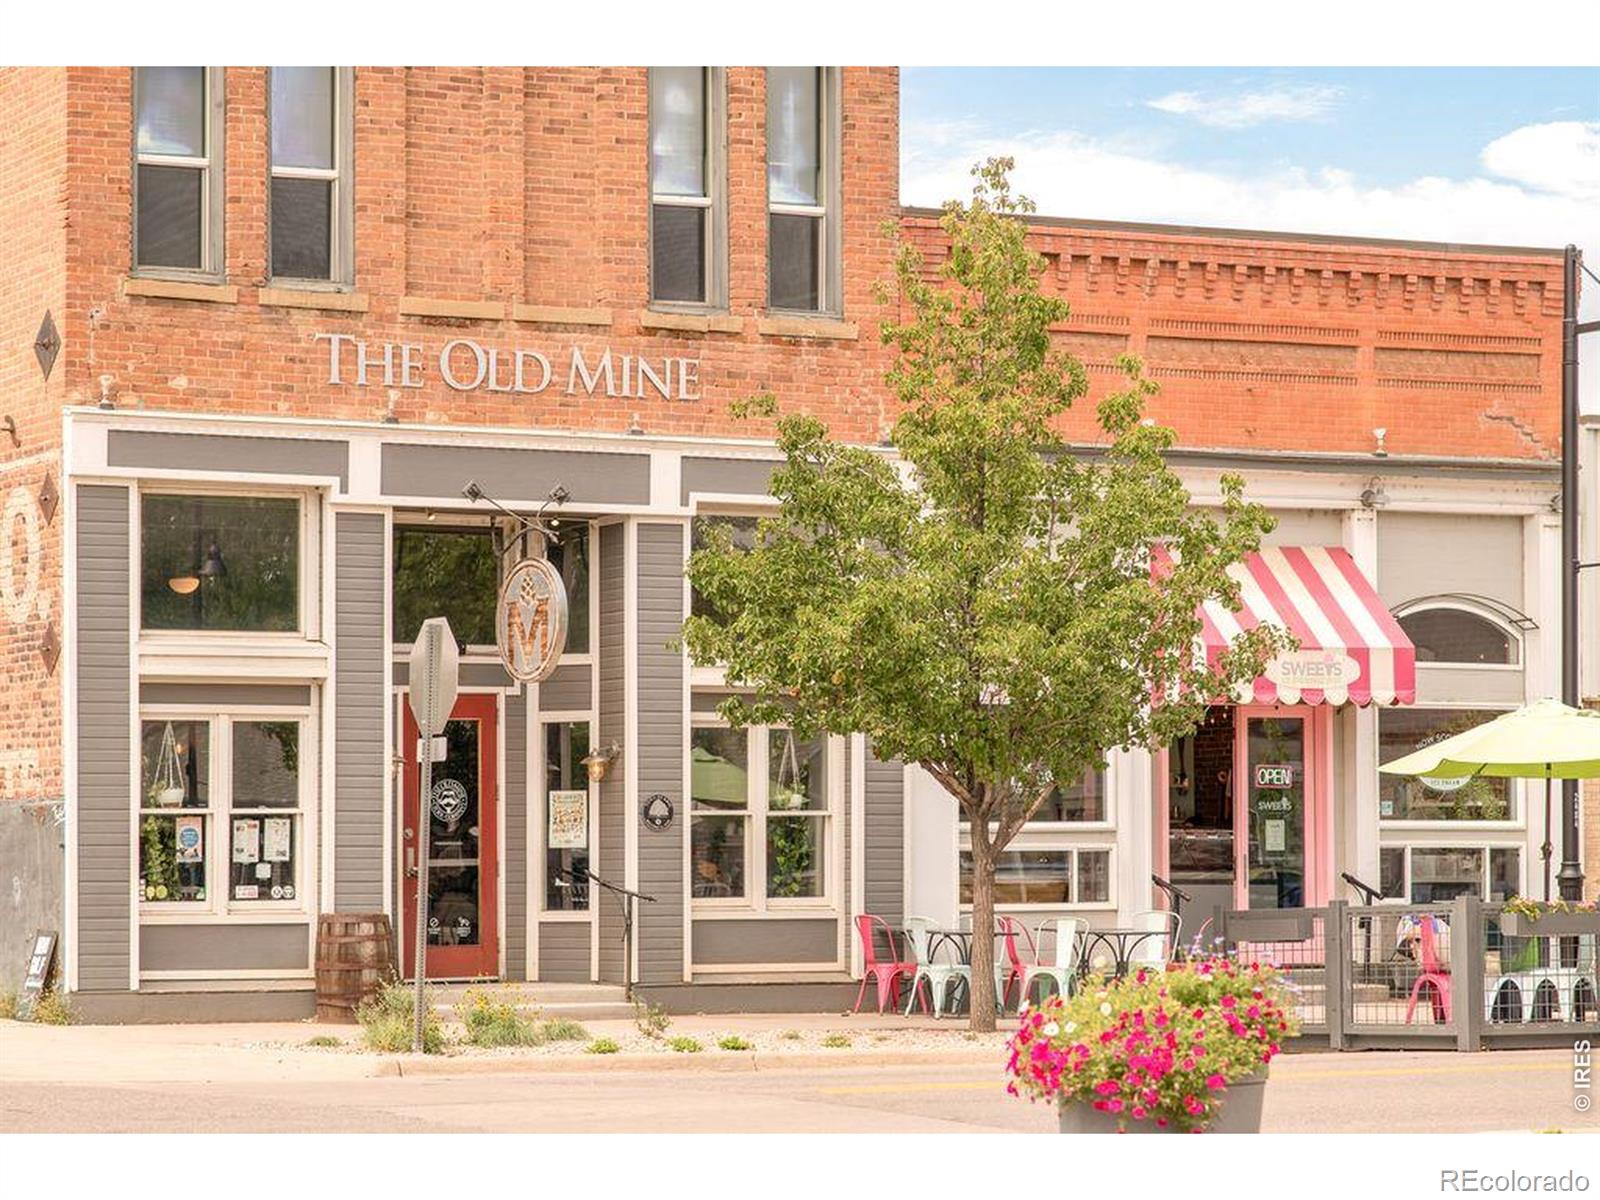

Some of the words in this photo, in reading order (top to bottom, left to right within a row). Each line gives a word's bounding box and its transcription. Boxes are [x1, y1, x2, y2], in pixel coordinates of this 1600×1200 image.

[314, 332, 424, 388] THE
[439, 339, 552, 394] OLD
[565, 345, 701, 400] MINE
[505, 596, 549, 667] M
[1258, 768, 1290, 785] OPEN
